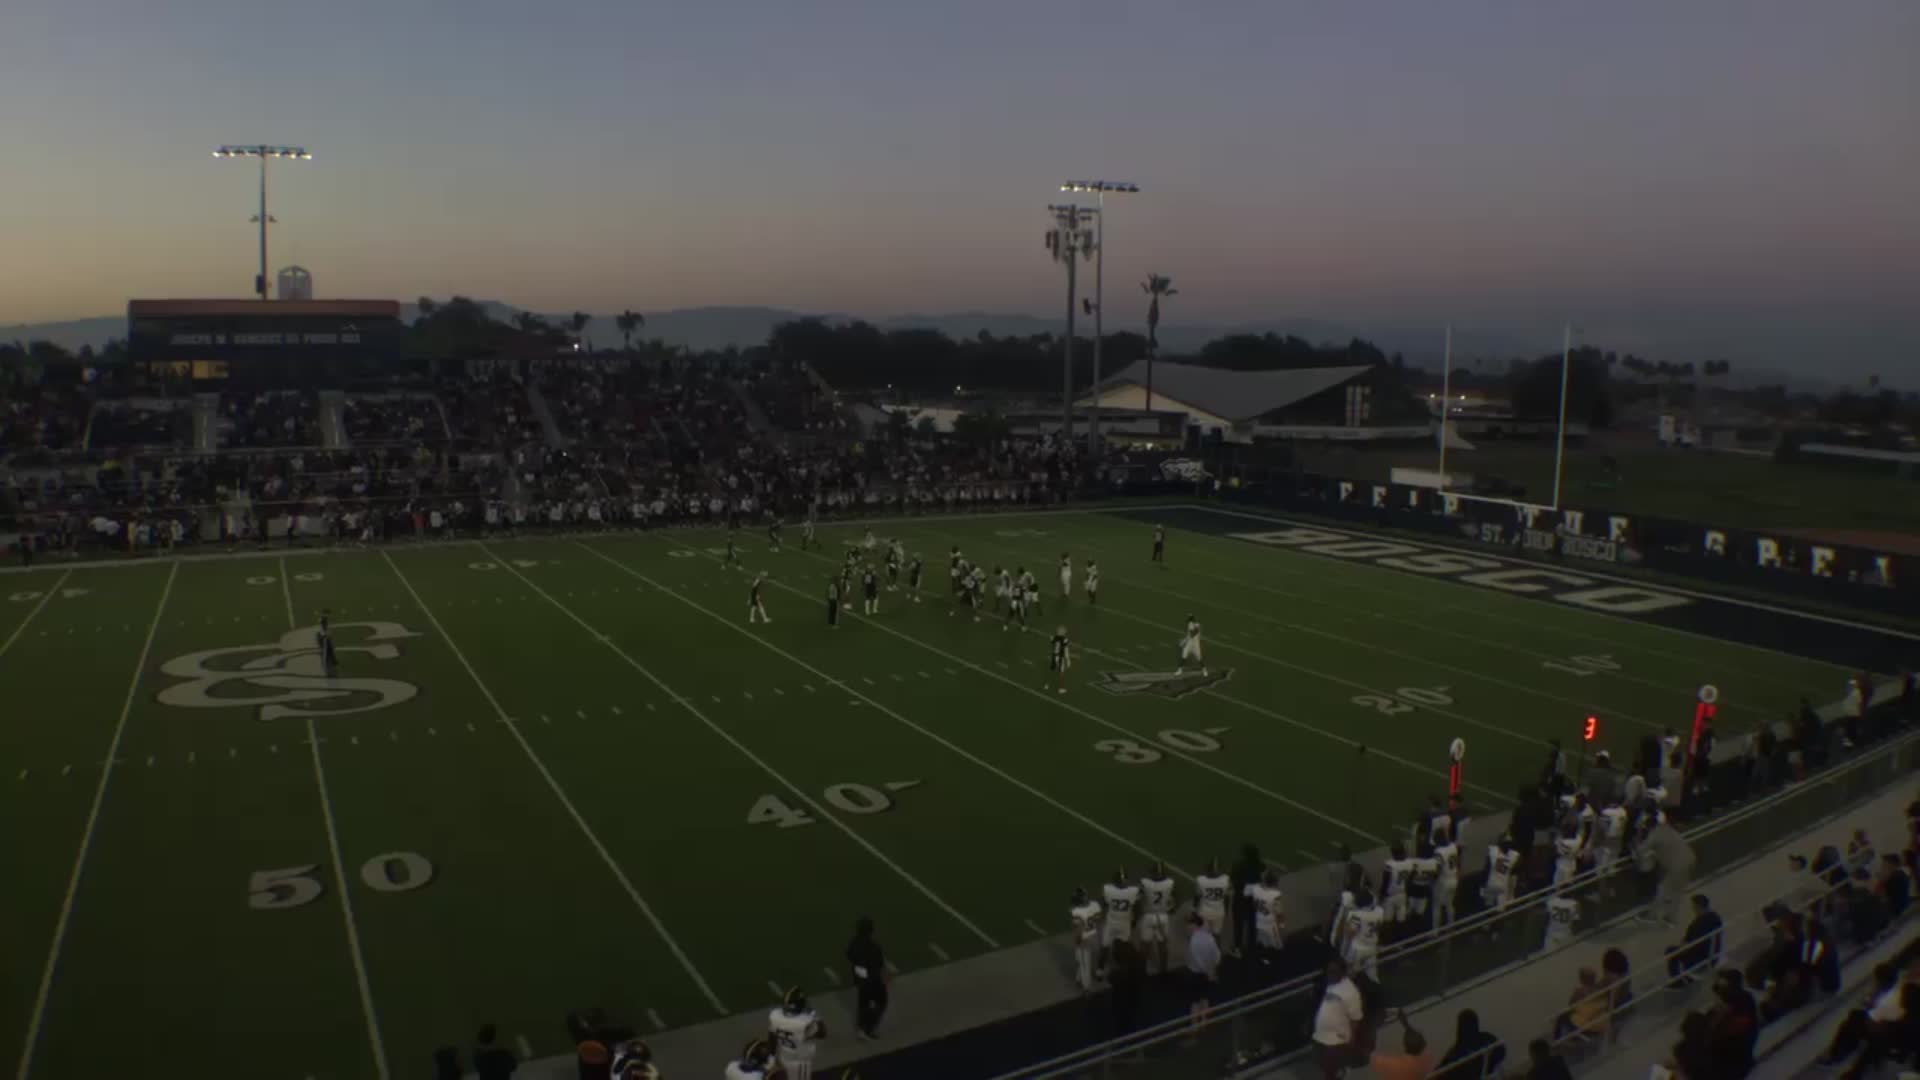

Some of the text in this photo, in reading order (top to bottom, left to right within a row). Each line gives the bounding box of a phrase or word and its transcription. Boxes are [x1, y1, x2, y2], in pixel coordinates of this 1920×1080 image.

[1226, 527, 1698, 614] BOSCO
[1352, 687, 1455, 715] 20
[1094, 728, 1222, 764] 30
[1583, 715, 1600, 742] 3
[746, 783, 892, 829] 40
[248, 850, 434, 910] 50
